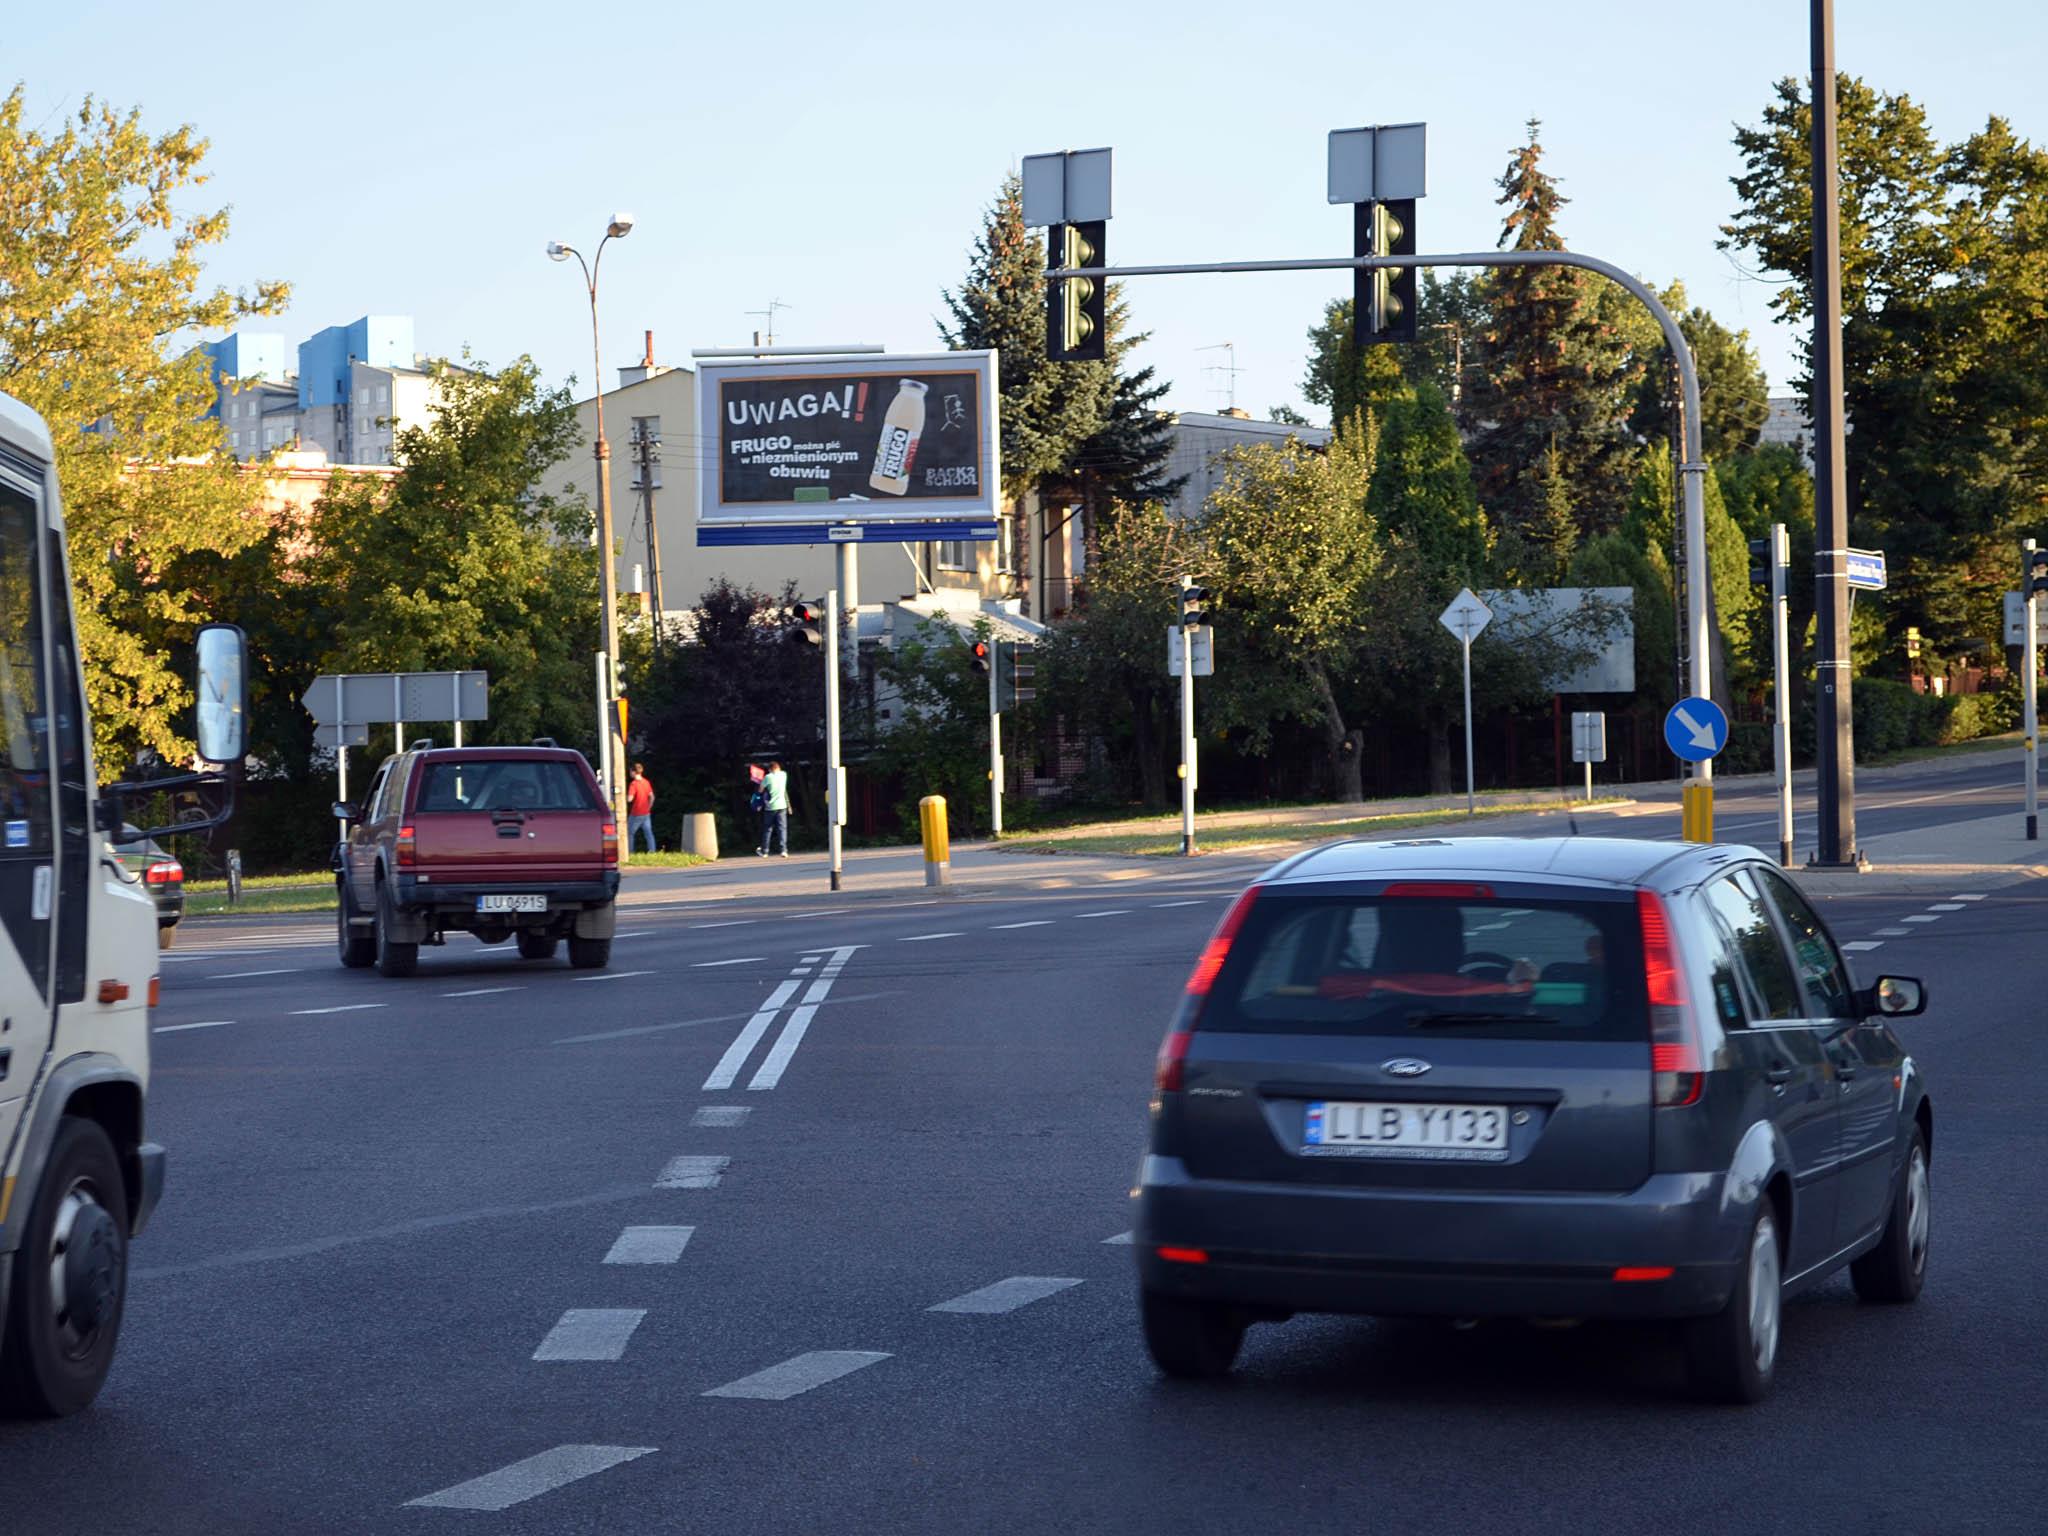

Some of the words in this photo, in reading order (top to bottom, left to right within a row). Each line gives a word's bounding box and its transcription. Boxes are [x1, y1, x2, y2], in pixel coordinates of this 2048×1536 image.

[728, 382, 869, 425] UWAGA!!
[731, 436, 792, 454] FRUGO
[752, 451, 859, 464] niezmienionym
[882, 430, 907, 477] FRUGO
[769, 464, 830, 479] obuwiu
[926, 475, 978, 486] SCHOOL
[485, 896, 503, 909] LU
[1328, 1106, 1400, 1140] LLB
[1417, 1108, 1500, 1143] Y133
